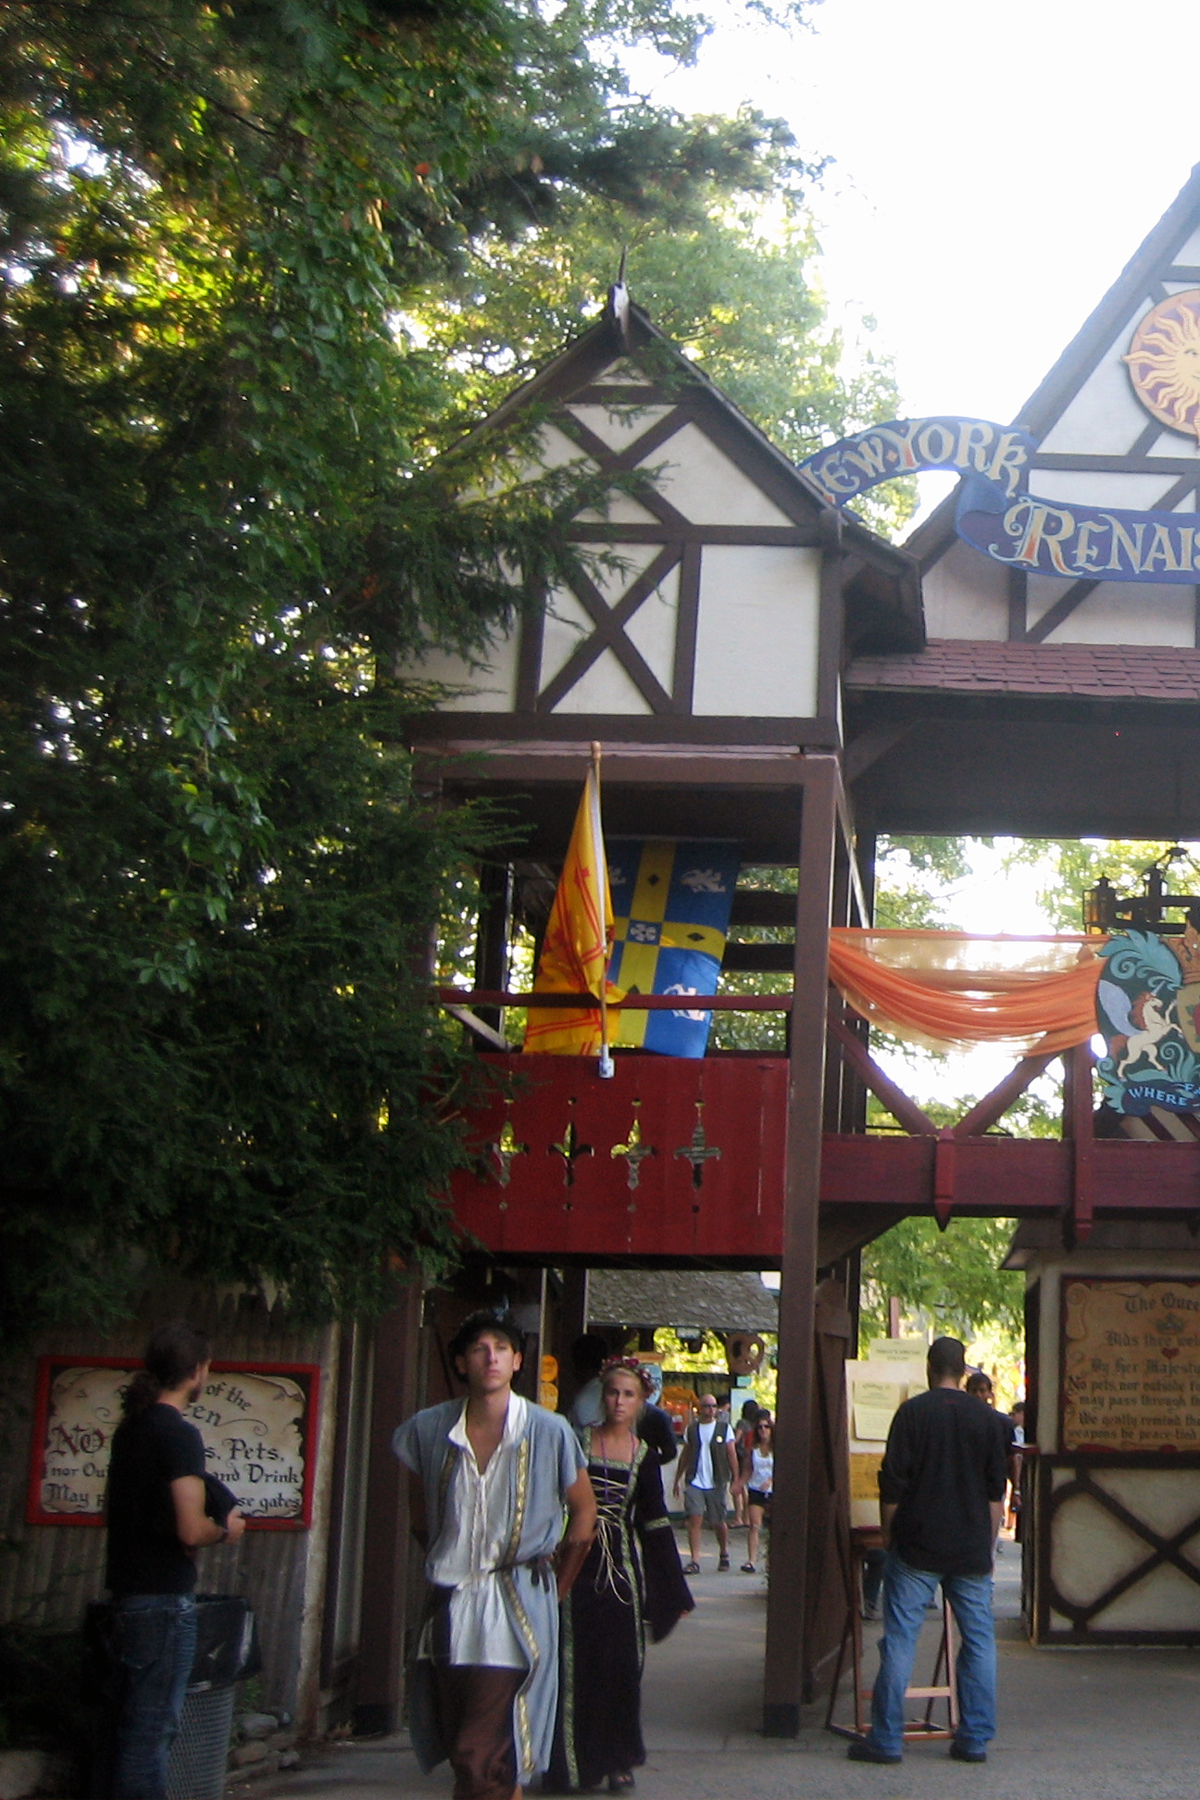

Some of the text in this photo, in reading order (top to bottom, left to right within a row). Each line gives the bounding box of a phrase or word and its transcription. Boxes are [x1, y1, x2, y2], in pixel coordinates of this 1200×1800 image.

[848, 418, 1029, 499] YORK
[1128, 1085, 1187, 1107] WHERE
[1125, 1297, 1156, 1314] The
[1142, 1379, 1185, 1392] outside
[205, 1382, 251, 1412] of the
[1141, 1394, 1186, 1414] through
[222, 1438, 284, 1462] Pets,
[52, 1466, 79, 1477] nor
[244, 1462, 299, 1484] Drink
[44, 1483, 89, 1508] May
[252, 1493, 300, 1514] gates
